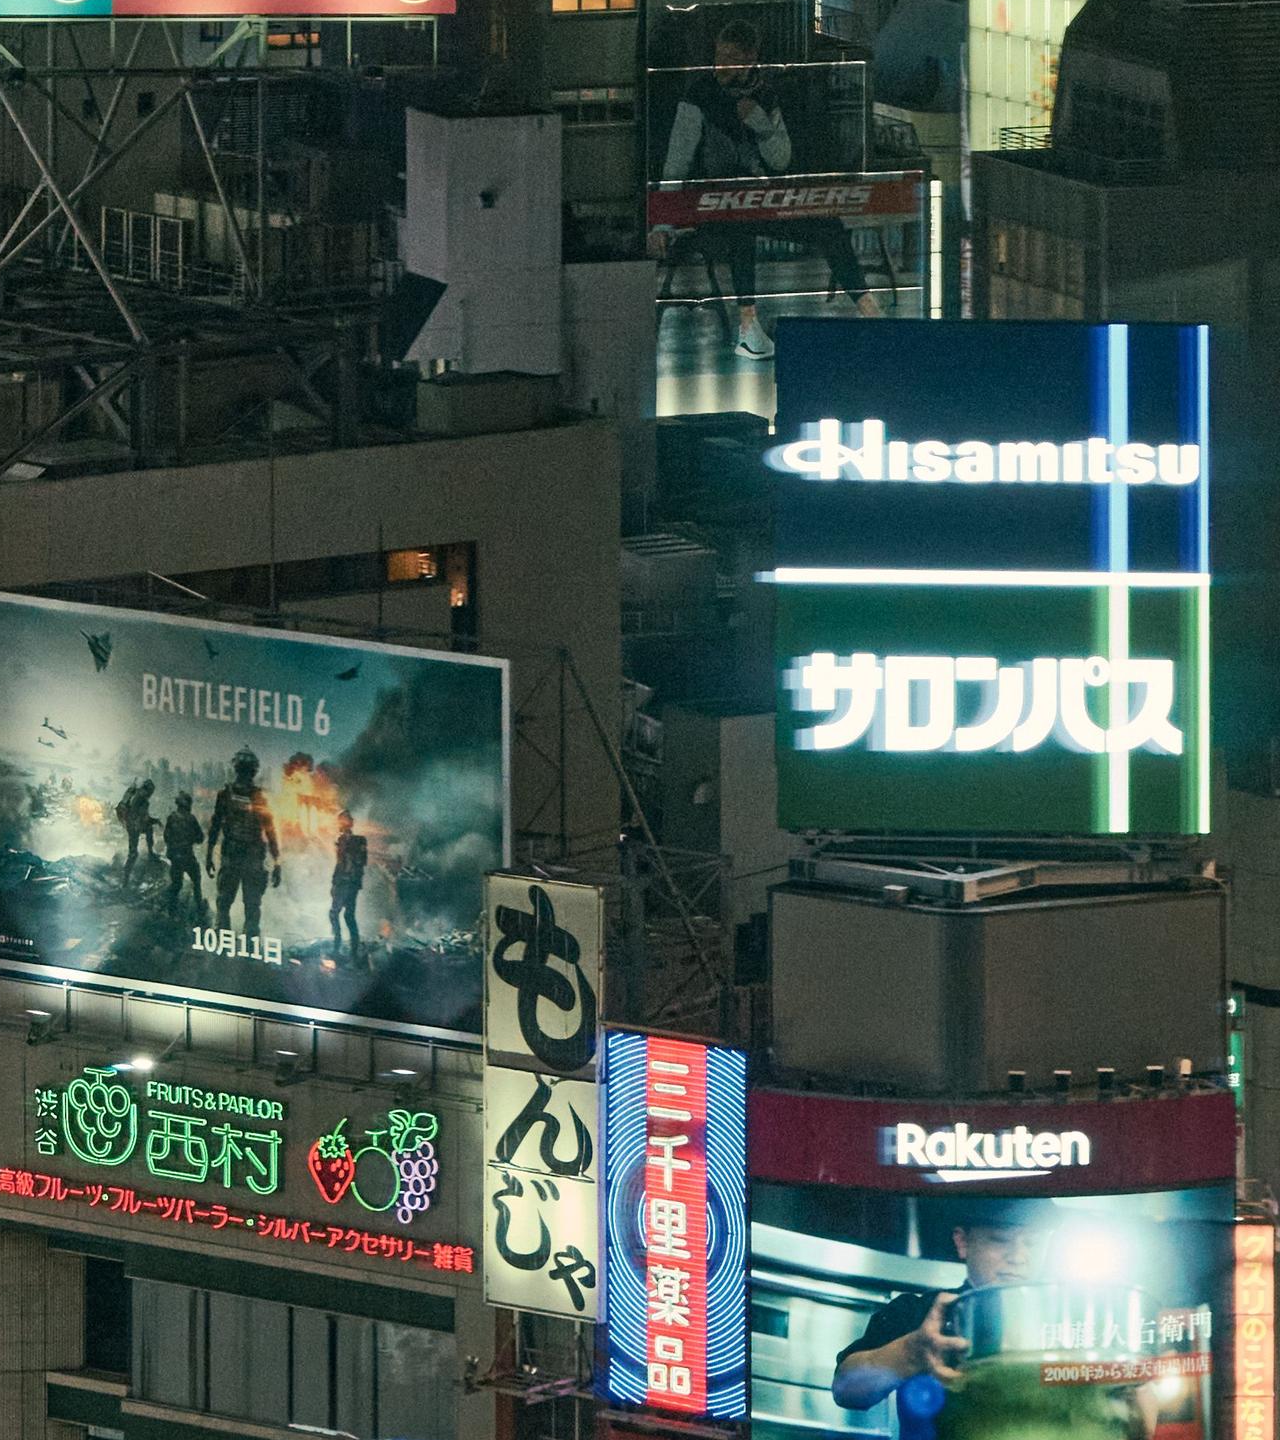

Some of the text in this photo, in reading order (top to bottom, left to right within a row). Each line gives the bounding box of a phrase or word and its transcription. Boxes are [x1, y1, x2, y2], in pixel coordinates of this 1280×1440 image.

[697, 185, 874, 211] SKECHERS
[781, 417, 1201, 486] Hisamitsu
[141, 672, 331, 737] BATTLEFIELD 6
[800, 649, 1183, 755] サロンパス
[191, 924, 284, 967] 10月11日
[34, 1087, 59, 1157] 渋谷
[491, 885, 597, 1309] もんじゃ
[147, 1109, 282, 1196] 西村
[896, 1122, 1091, 1170] Rakuten
[646, 1059, 693, 1397] 三千里薬品
